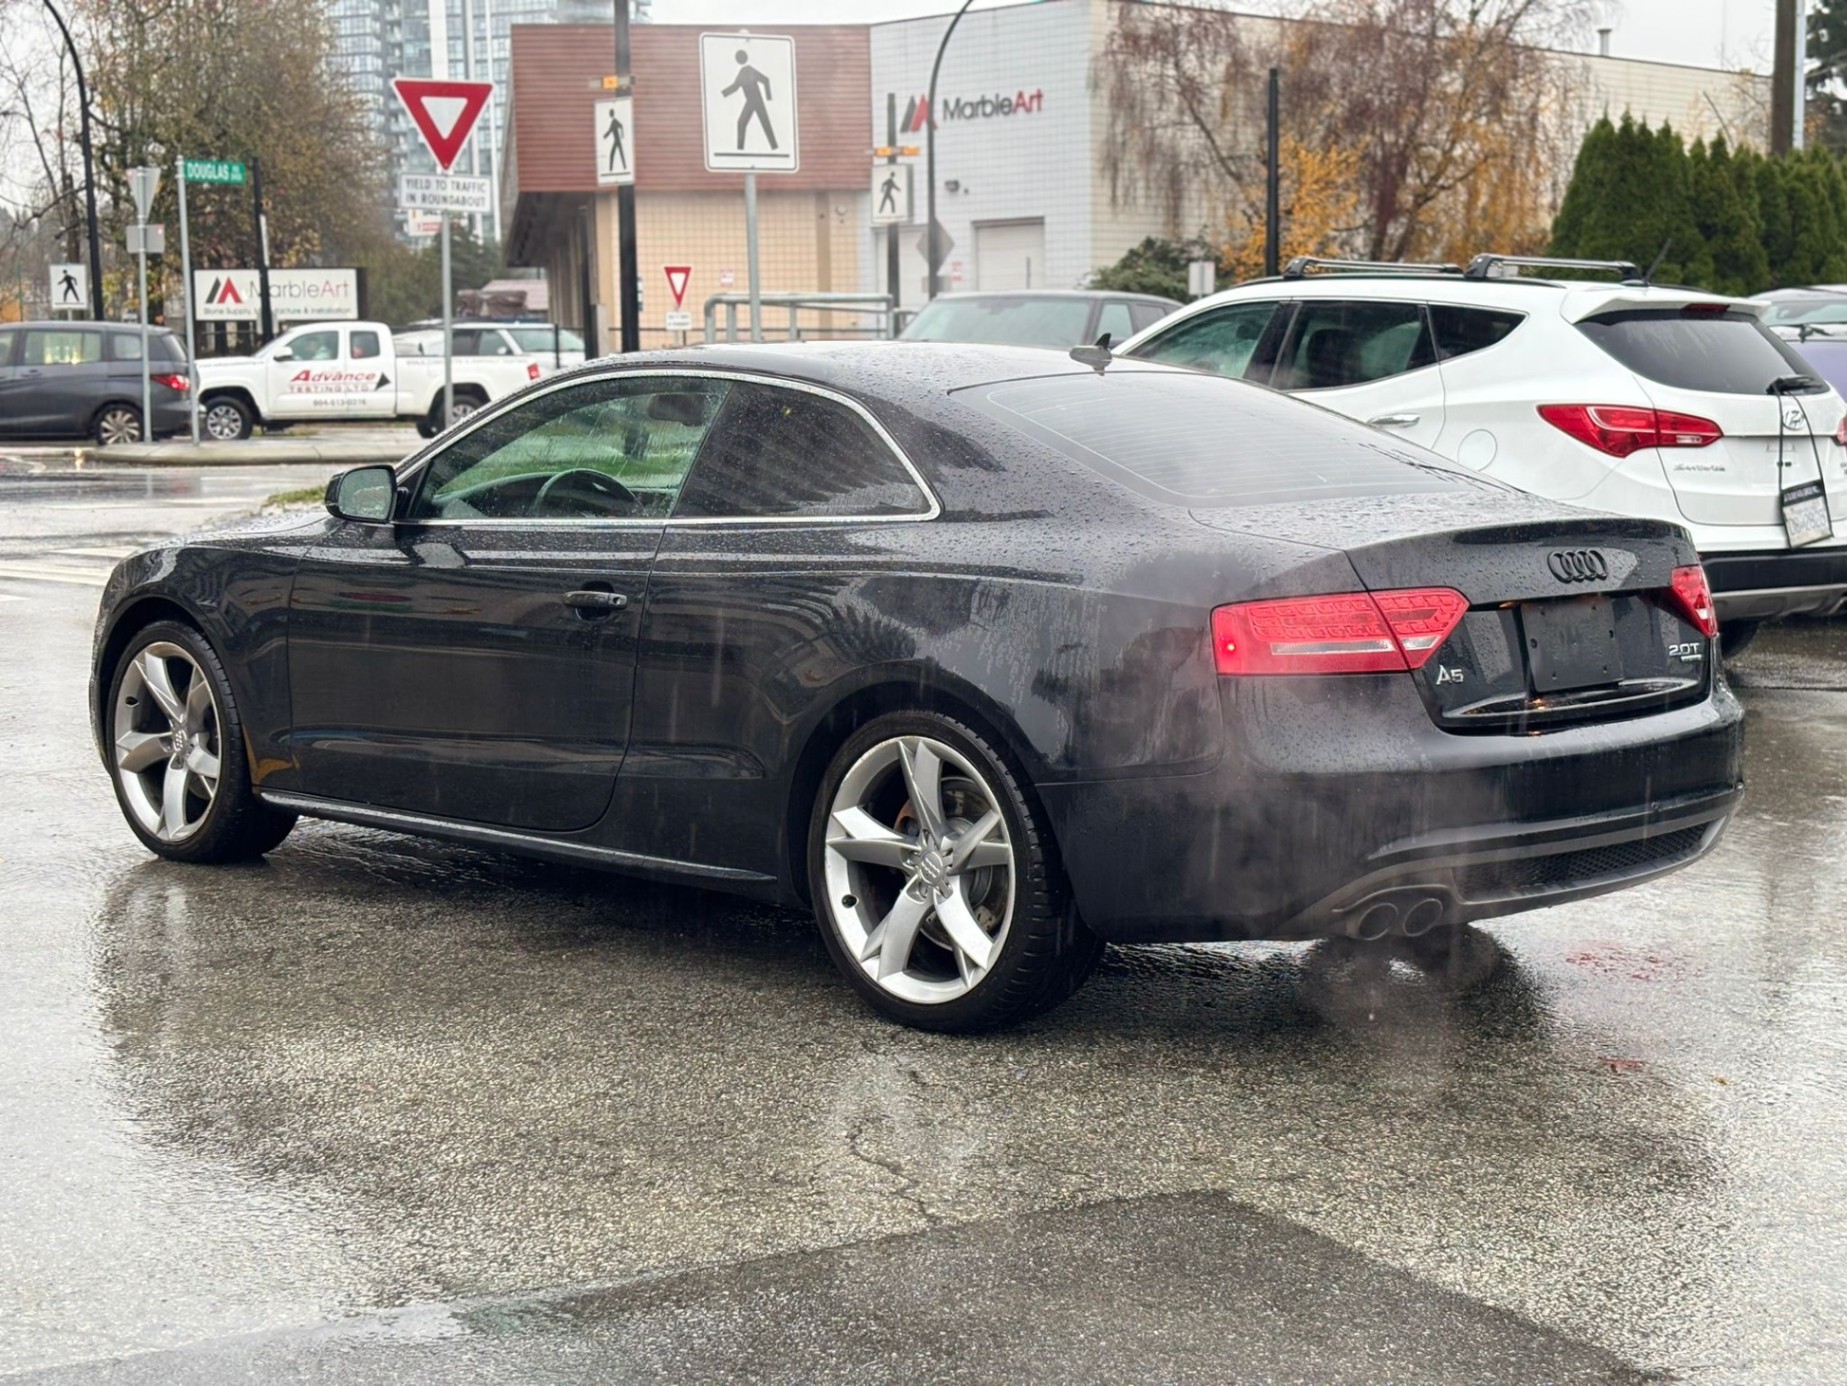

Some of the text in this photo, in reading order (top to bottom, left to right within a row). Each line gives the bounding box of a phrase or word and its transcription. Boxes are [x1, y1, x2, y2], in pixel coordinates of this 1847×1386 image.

[943, 88, 1043, 121] MarbleArt
[187, 162, 229, 181] DOUGLAS
[406, 178, 486, 193] YIELD TO TRAFFIC
[406, 193, 485, 207] IN ROUNDABOUT
[291, 369, 376, 382] Advance
[1435, 664, 1464, 685] A5
